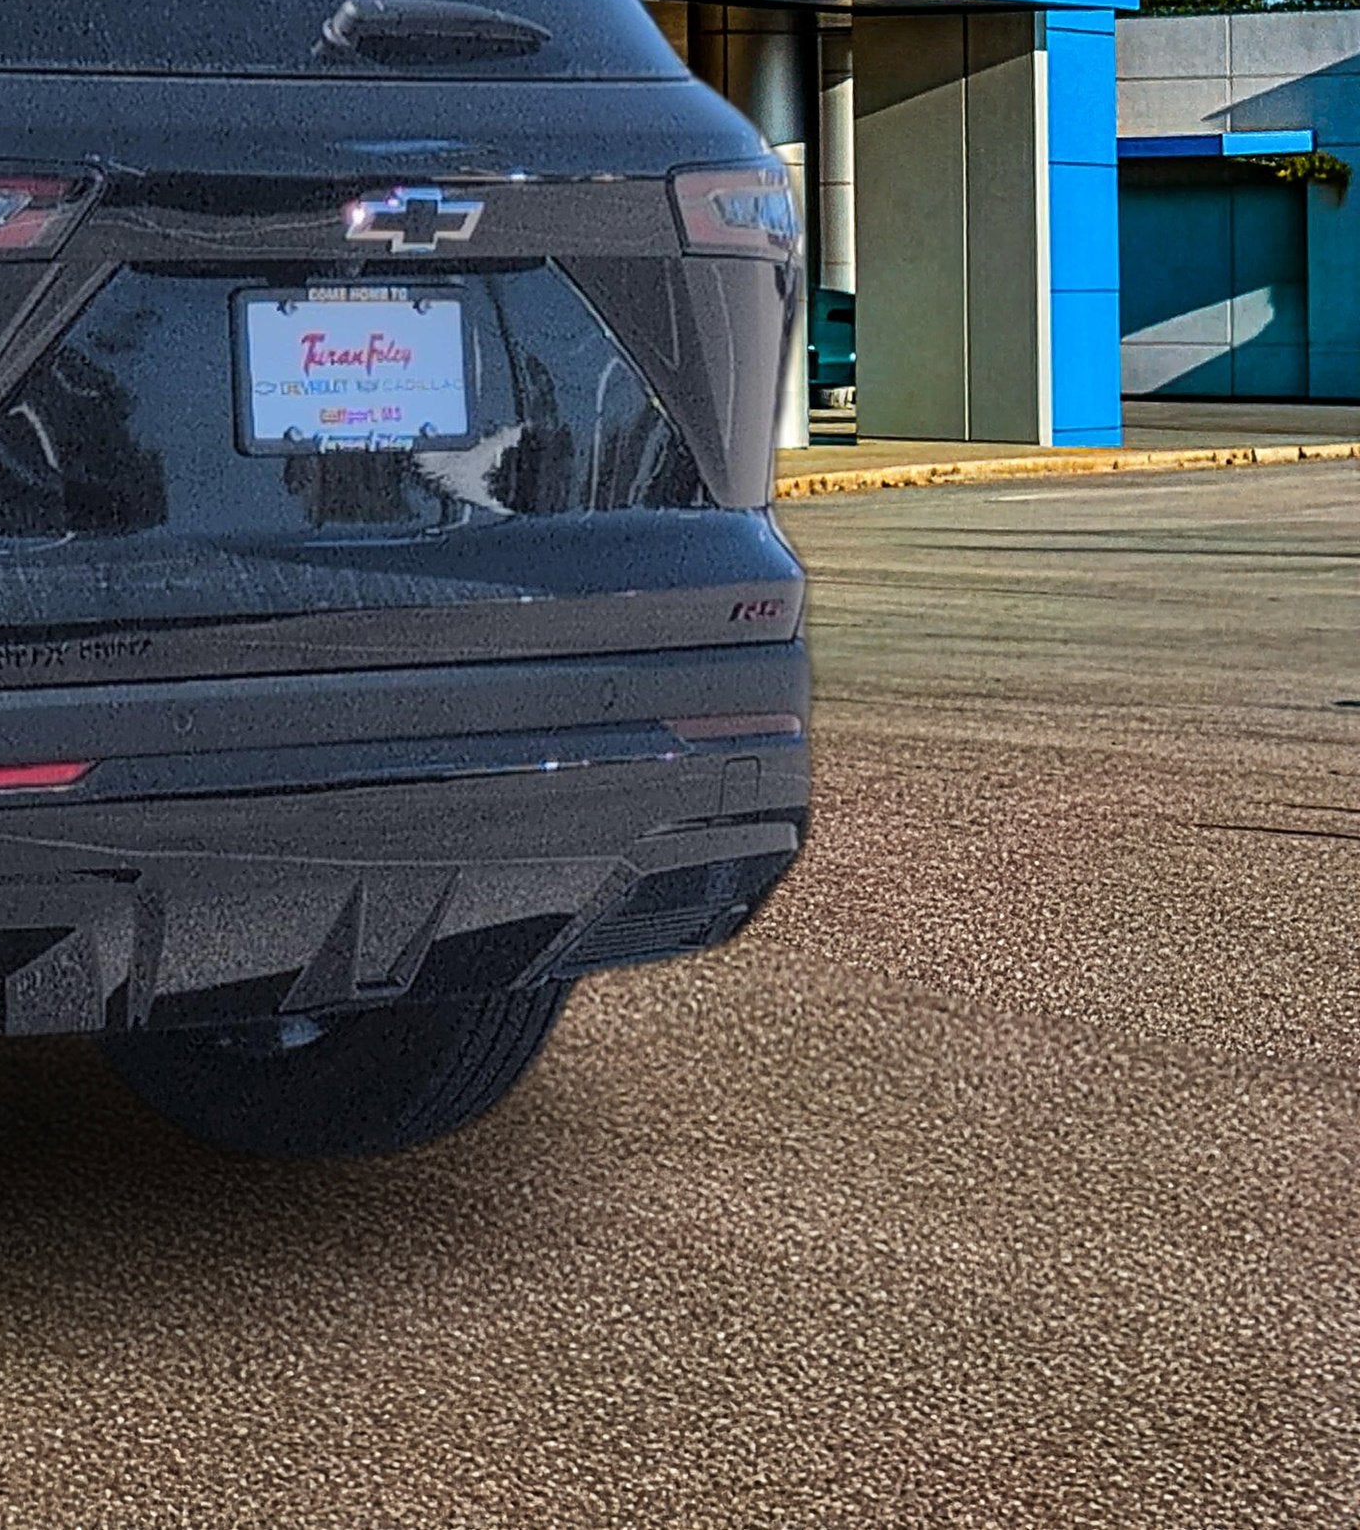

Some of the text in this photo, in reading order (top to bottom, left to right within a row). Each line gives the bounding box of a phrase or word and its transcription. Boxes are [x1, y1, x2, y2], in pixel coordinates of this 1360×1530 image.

[308, 287, 347, 301] COME
[389, 287, 408, 301] TO
[301, 332, 412, 376] Turan Foley
